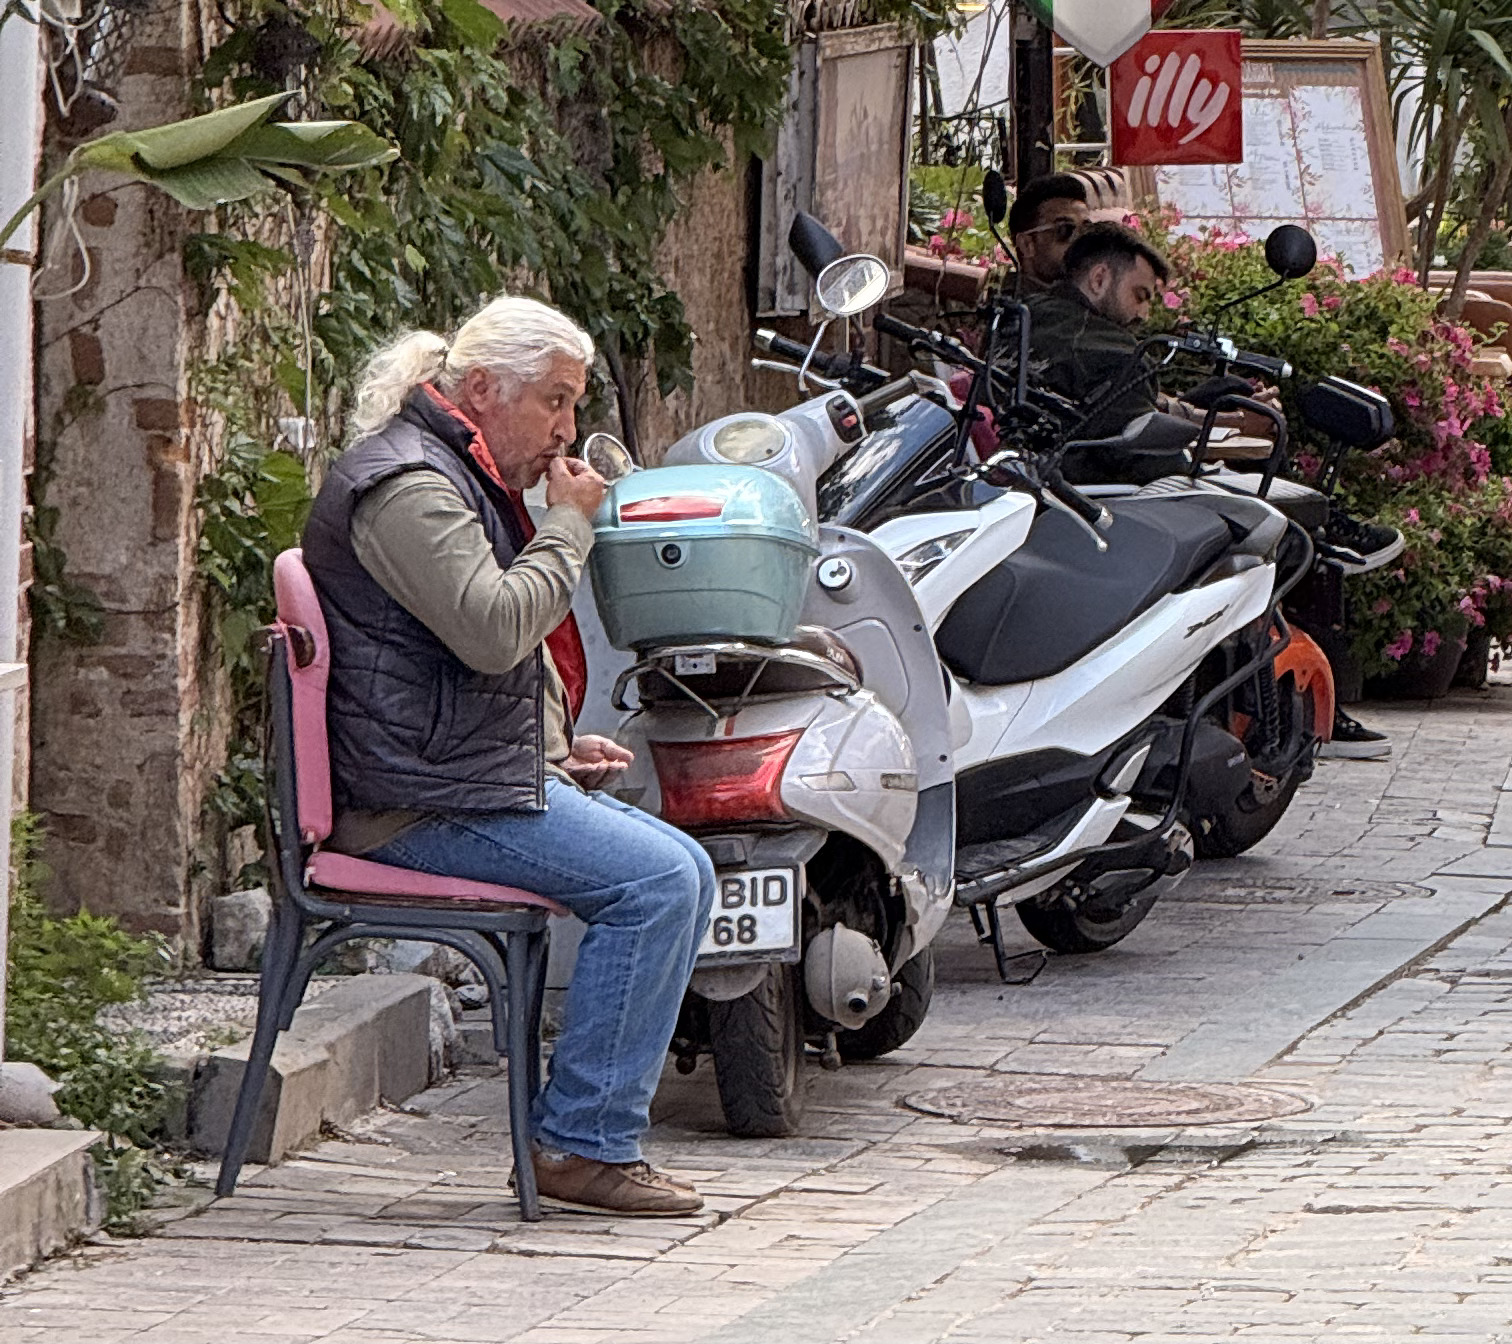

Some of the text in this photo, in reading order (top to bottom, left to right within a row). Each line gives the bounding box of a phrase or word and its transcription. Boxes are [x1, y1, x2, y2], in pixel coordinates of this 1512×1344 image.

[1127, 51, 1230, 144] illy
[721, 875, 788, 909] BID
[708, 913, 757, 946] 68
